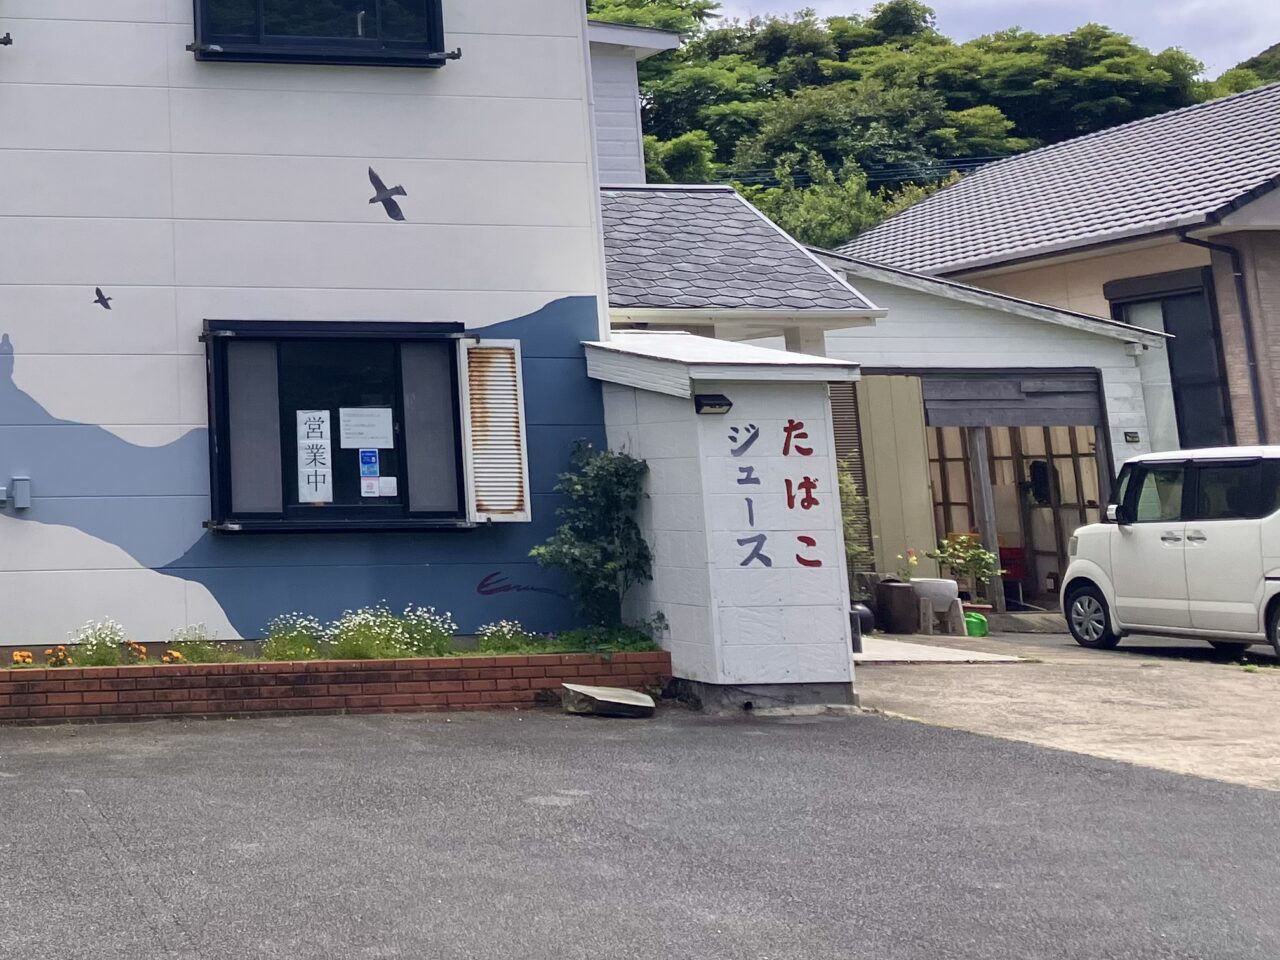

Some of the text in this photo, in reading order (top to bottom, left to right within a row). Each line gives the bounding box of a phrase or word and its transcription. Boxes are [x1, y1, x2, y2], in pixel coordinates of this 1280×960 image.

[303, 416, 327, 493] 営業中
[727, 423, 772, 568] ジュース
[782, 419, 822, 568] たばこ
